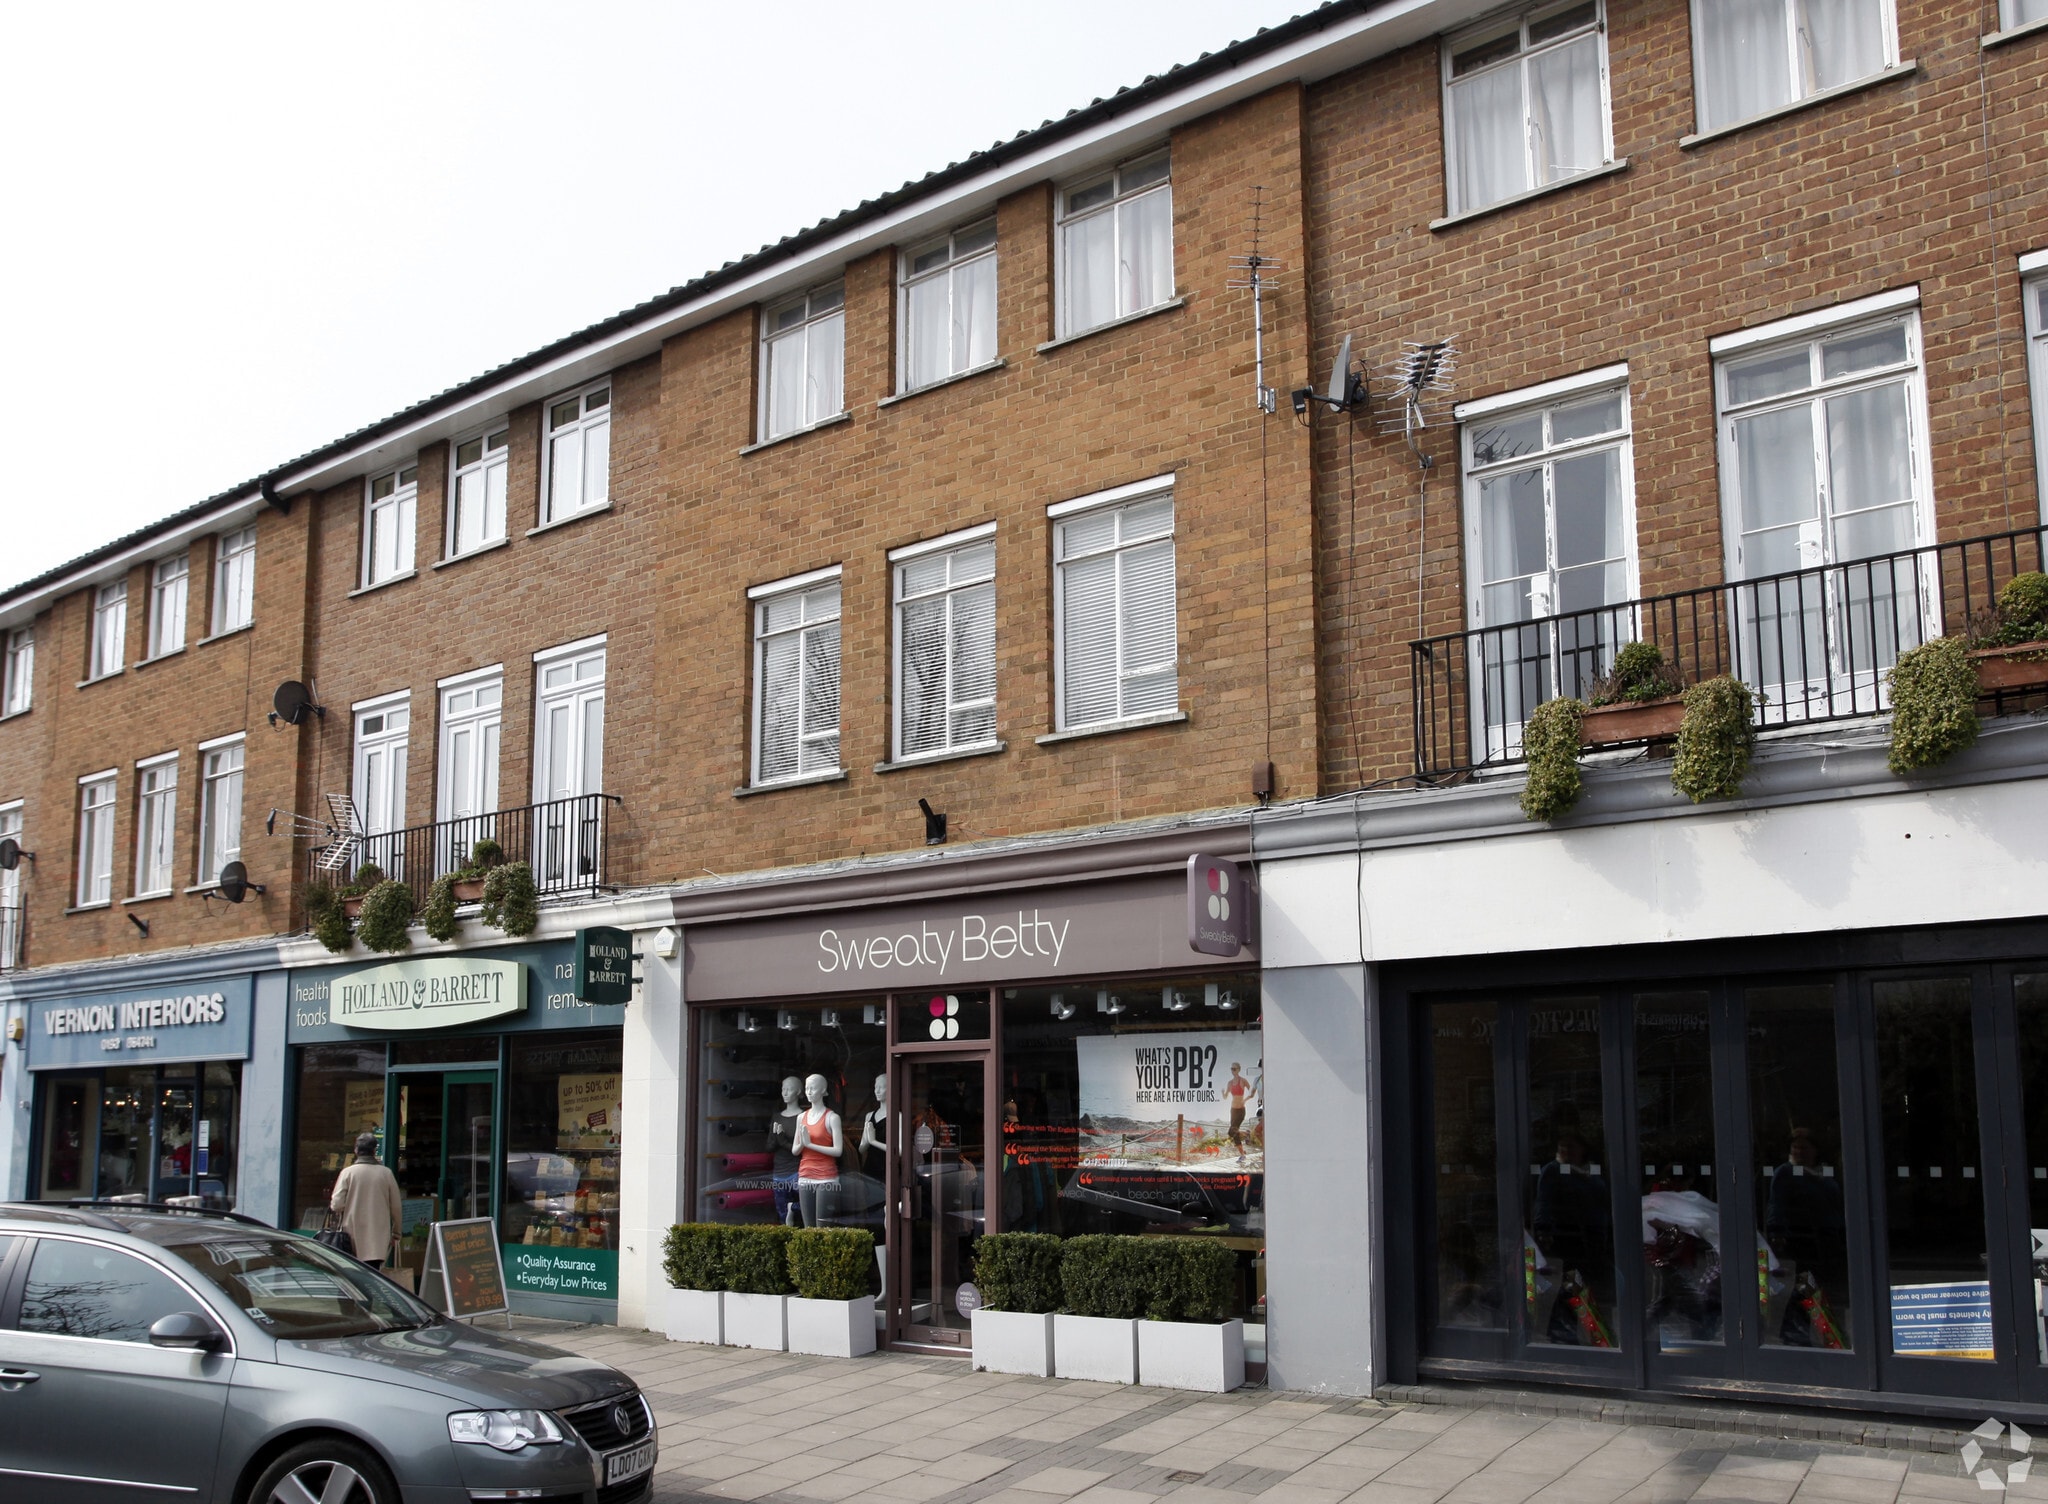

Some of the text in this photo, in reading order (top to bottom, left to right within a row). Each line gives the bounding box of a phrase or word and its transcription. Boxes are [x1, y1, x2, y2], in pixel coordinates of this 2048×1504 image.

[589, 944, 628, 960] HOLLAND
[817, 908, 1071, 976] Sweaty Betty
[588, 970, 627, 985] BARRETT
[295, 981, 329, 1002] health
[341, 971, 504, 1014] HOLLAND & BARRETT
[44, 993, 225, 1036] VERNON INTERIORS
[296, 1008, 328, 1028] foods
[1135, 1046, 1171, 1066] WHAT'S
[1173, 1044, 1218, 1089] PB?
[575, 1084, 583, 1095] to
[585, 1079, 602, 1093] 50%
[604, 1077, 615, 1090] off
[1135, 1065, 1171, 1089] YOUR
[1136, 1090, 1152, 1103] HERE
[1153, 1090, 1166, 1103] ARE
[1166, 1090, 1171, 1103] A
[1172, 1090, 1186, 1103] FEW
[1186, 1090, 1195, 1103] OF
[1128, 1188, 1164, 1200] beach
[1170, 1191, 1200, 1200] snow
[522, 1253, 596, 1271] Quality Assurance
[522, 1271, 608, 1291] Everyday Low Prices
[1916, 1313, 1926, 1321] be
[1949, 1312, 1980, 1320] helmets
[611, 1451, 638, 1478] LD07
